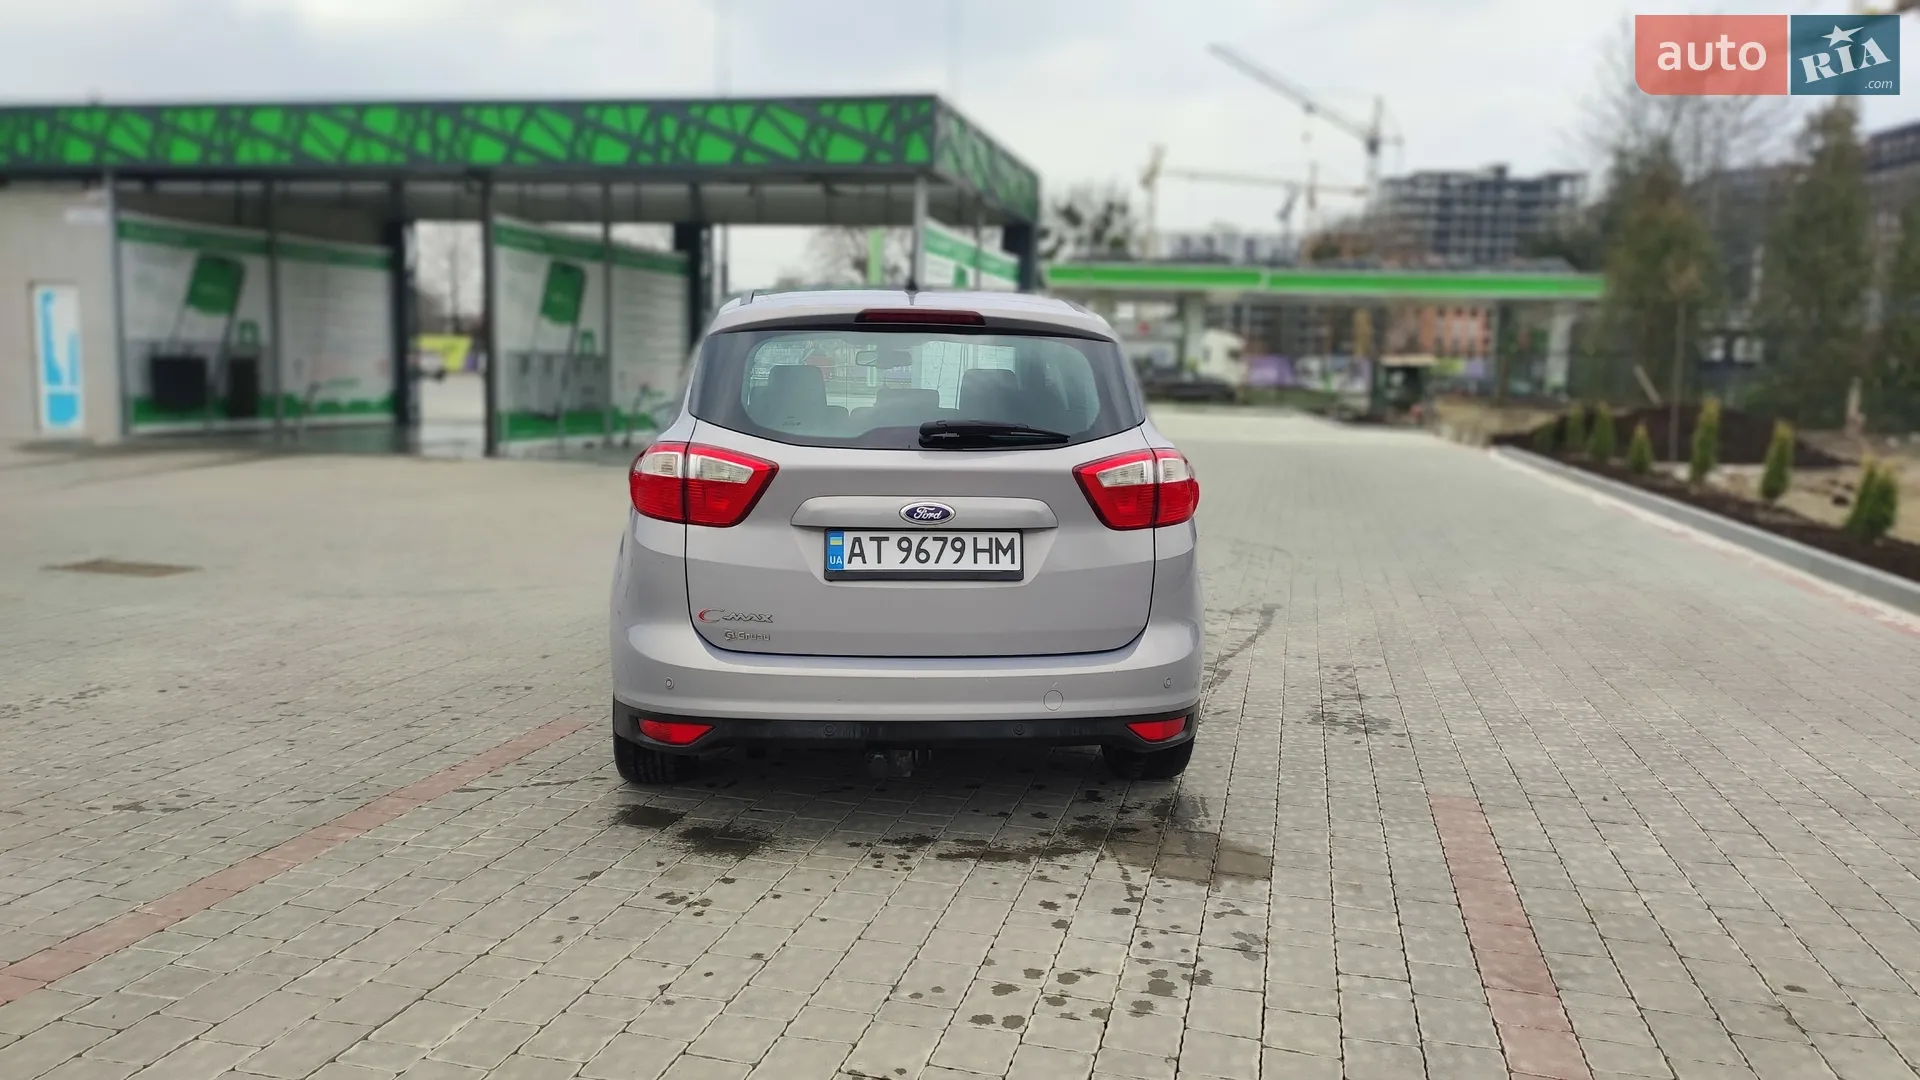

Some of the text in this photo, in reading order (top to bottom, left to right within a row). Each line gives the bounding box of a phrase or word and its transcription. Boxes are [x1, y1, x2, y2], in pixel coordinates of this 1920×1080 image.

[914, 506, 942, 520] Ford
[847, 537, 1015, 564] AT 9679 HM
[830, 556, 843, 565] UA
